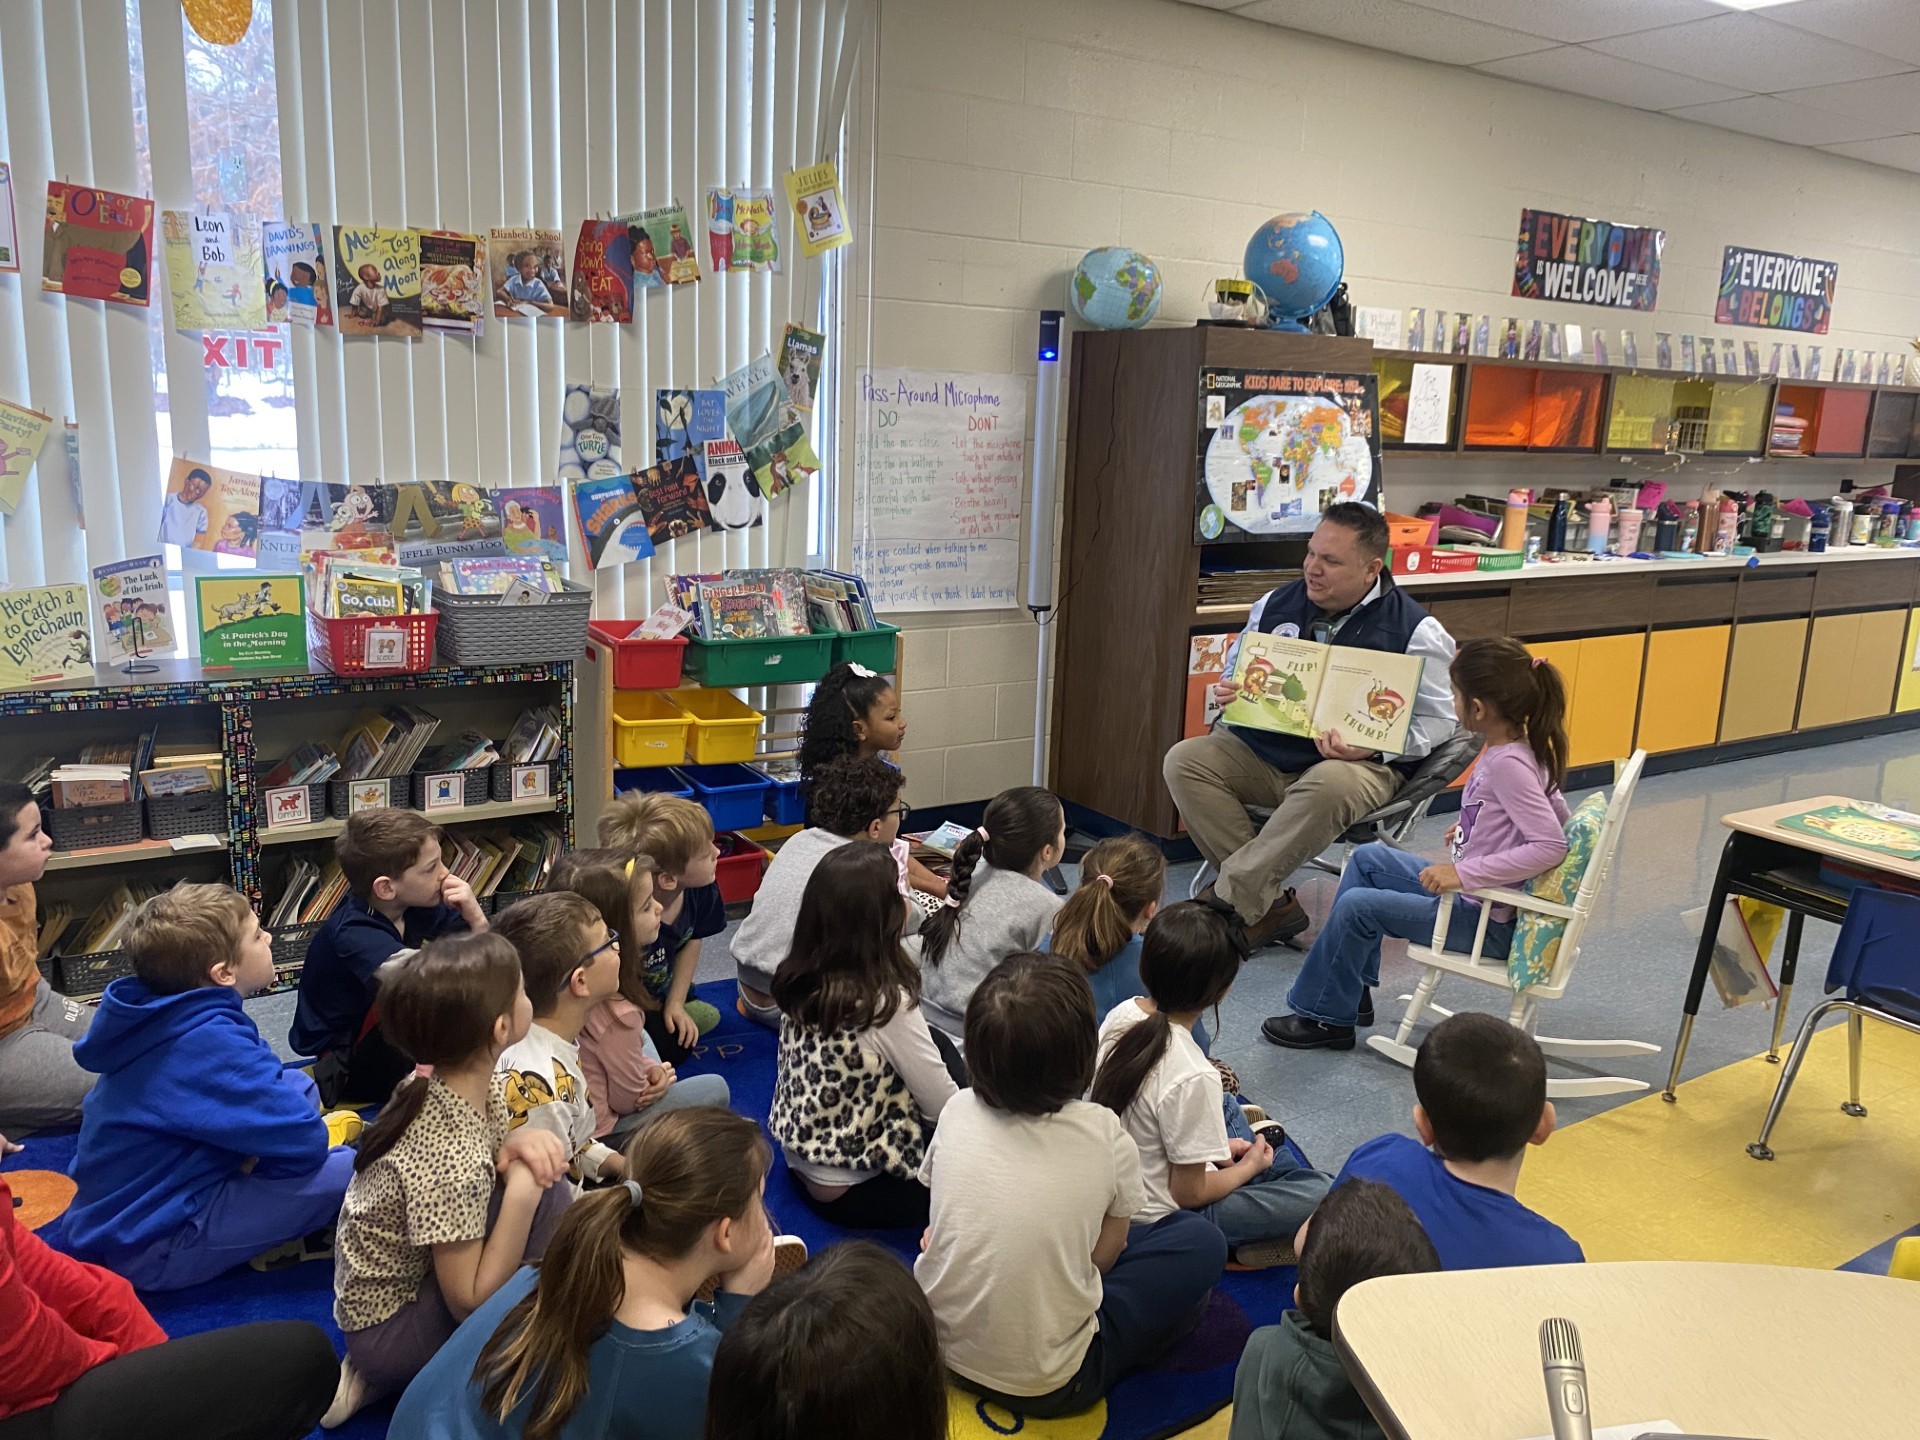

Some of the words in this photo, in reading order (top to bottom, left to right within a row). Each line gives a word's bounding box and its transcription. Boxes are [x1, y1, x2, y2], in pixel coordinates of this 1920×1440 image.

[798, 169, 829, 187] JULIUS
[71, 189, 113, 216] One
[117, 198, 134, 210] of
[100, 205, 133, 227] Each
[644, 209, 658, 220] Blue
[660, 206, 684, 217] Marker
[195, 216, 225, 232] Leon
[205, 236, 220, 244] and
[268, 226, 304, 243] DAVID'S
[535, 231, 561, 242] School
[266, 240, 315, 258] DRAWINGS
[345, 228, 379, 262] Max
[1534, 215, 1654, 271] EVERYONE
[203, 246, 225, 262] Bob
[1740, 252, 1824, 296] EVERYONE
[384, 272, 418, 296] Moon
[592, 277, 614, 292] EAT
[1536, 260, 1544, 275] IS
[1544, 262, 1636, 307] WELCOME
[1738, 289, 1815, 330] BELONGS
[203, 336, 281, 369] XIT
[787, 337, 818, 354] Llamas
[724, 367, 770, 399] WHALE
[1244, 374, 1268, 390] KIDS
[1268, 375, 1292, 391] DARE
[1292, 377, 1303, 391] TO
[863, 374, 939, 406] Pass-Around
[944, 381, 1000, 412] Microphone
[697, 408, 720, 416] LOVES
[1, 409, 42, 432] Invited
[697, 425, 720, 433] NIGHT
[578, 440, 606, 454] TURTLE
[708, 441, 743, 456] ANIMA
[860, 434, 878, 449] Hld
[883, 433, 895, 448] the
[708, 457, 725, 465] Black
[860, 455, 881, 470] Pess
[925, 470, 936, 485] off
[872, 489, 898, 505] careful
[260, 539, 301, 553] KNUF
[399, 548, 433, 560] UFFLE
[436, 544, 475, 554] BUNNY
[477, 541, 502, 549] TOO
[894, 543, 920, 556] contact
[944, 540, 967, 555] talking
[910, 560, 932, 576] speak
[936, 556, 967, 572] normally
[123, 576, 138, 585] The
[139, 571, 158, 582] Luck
[880, 578, 904, 590] closer
[122, 587, 130, 595] of
[131, 584, 144, 593] the
[145, 581, 164, 591] Irish
[341, 593, 364, 608] Go,
[365, 595, 395, 608] Cub!
[889, 586, 919, 608] yourself
[0, 593, 32, 620] How
[3, 623, 21, 639] to
[21, 591, 62, 627] Catch
[66, 590, 75, 604] a
[2, 610, 84, 667] Leprechaun
[232, 631, 269, 640] Patrick's
[271, 631, 288, 639] Day
[247, 639, 286, 648] Morning
[1287, 661, 1318, 672] FLIP!
[235, 690, 266, 700] BELIEVE
[50, 703, 66, 712] YOU
[79, 701, 113, 710] BELIEVE
[1343, 712, 1389, 742] THUMP!
[277, 810, 302, 820] Clifford
